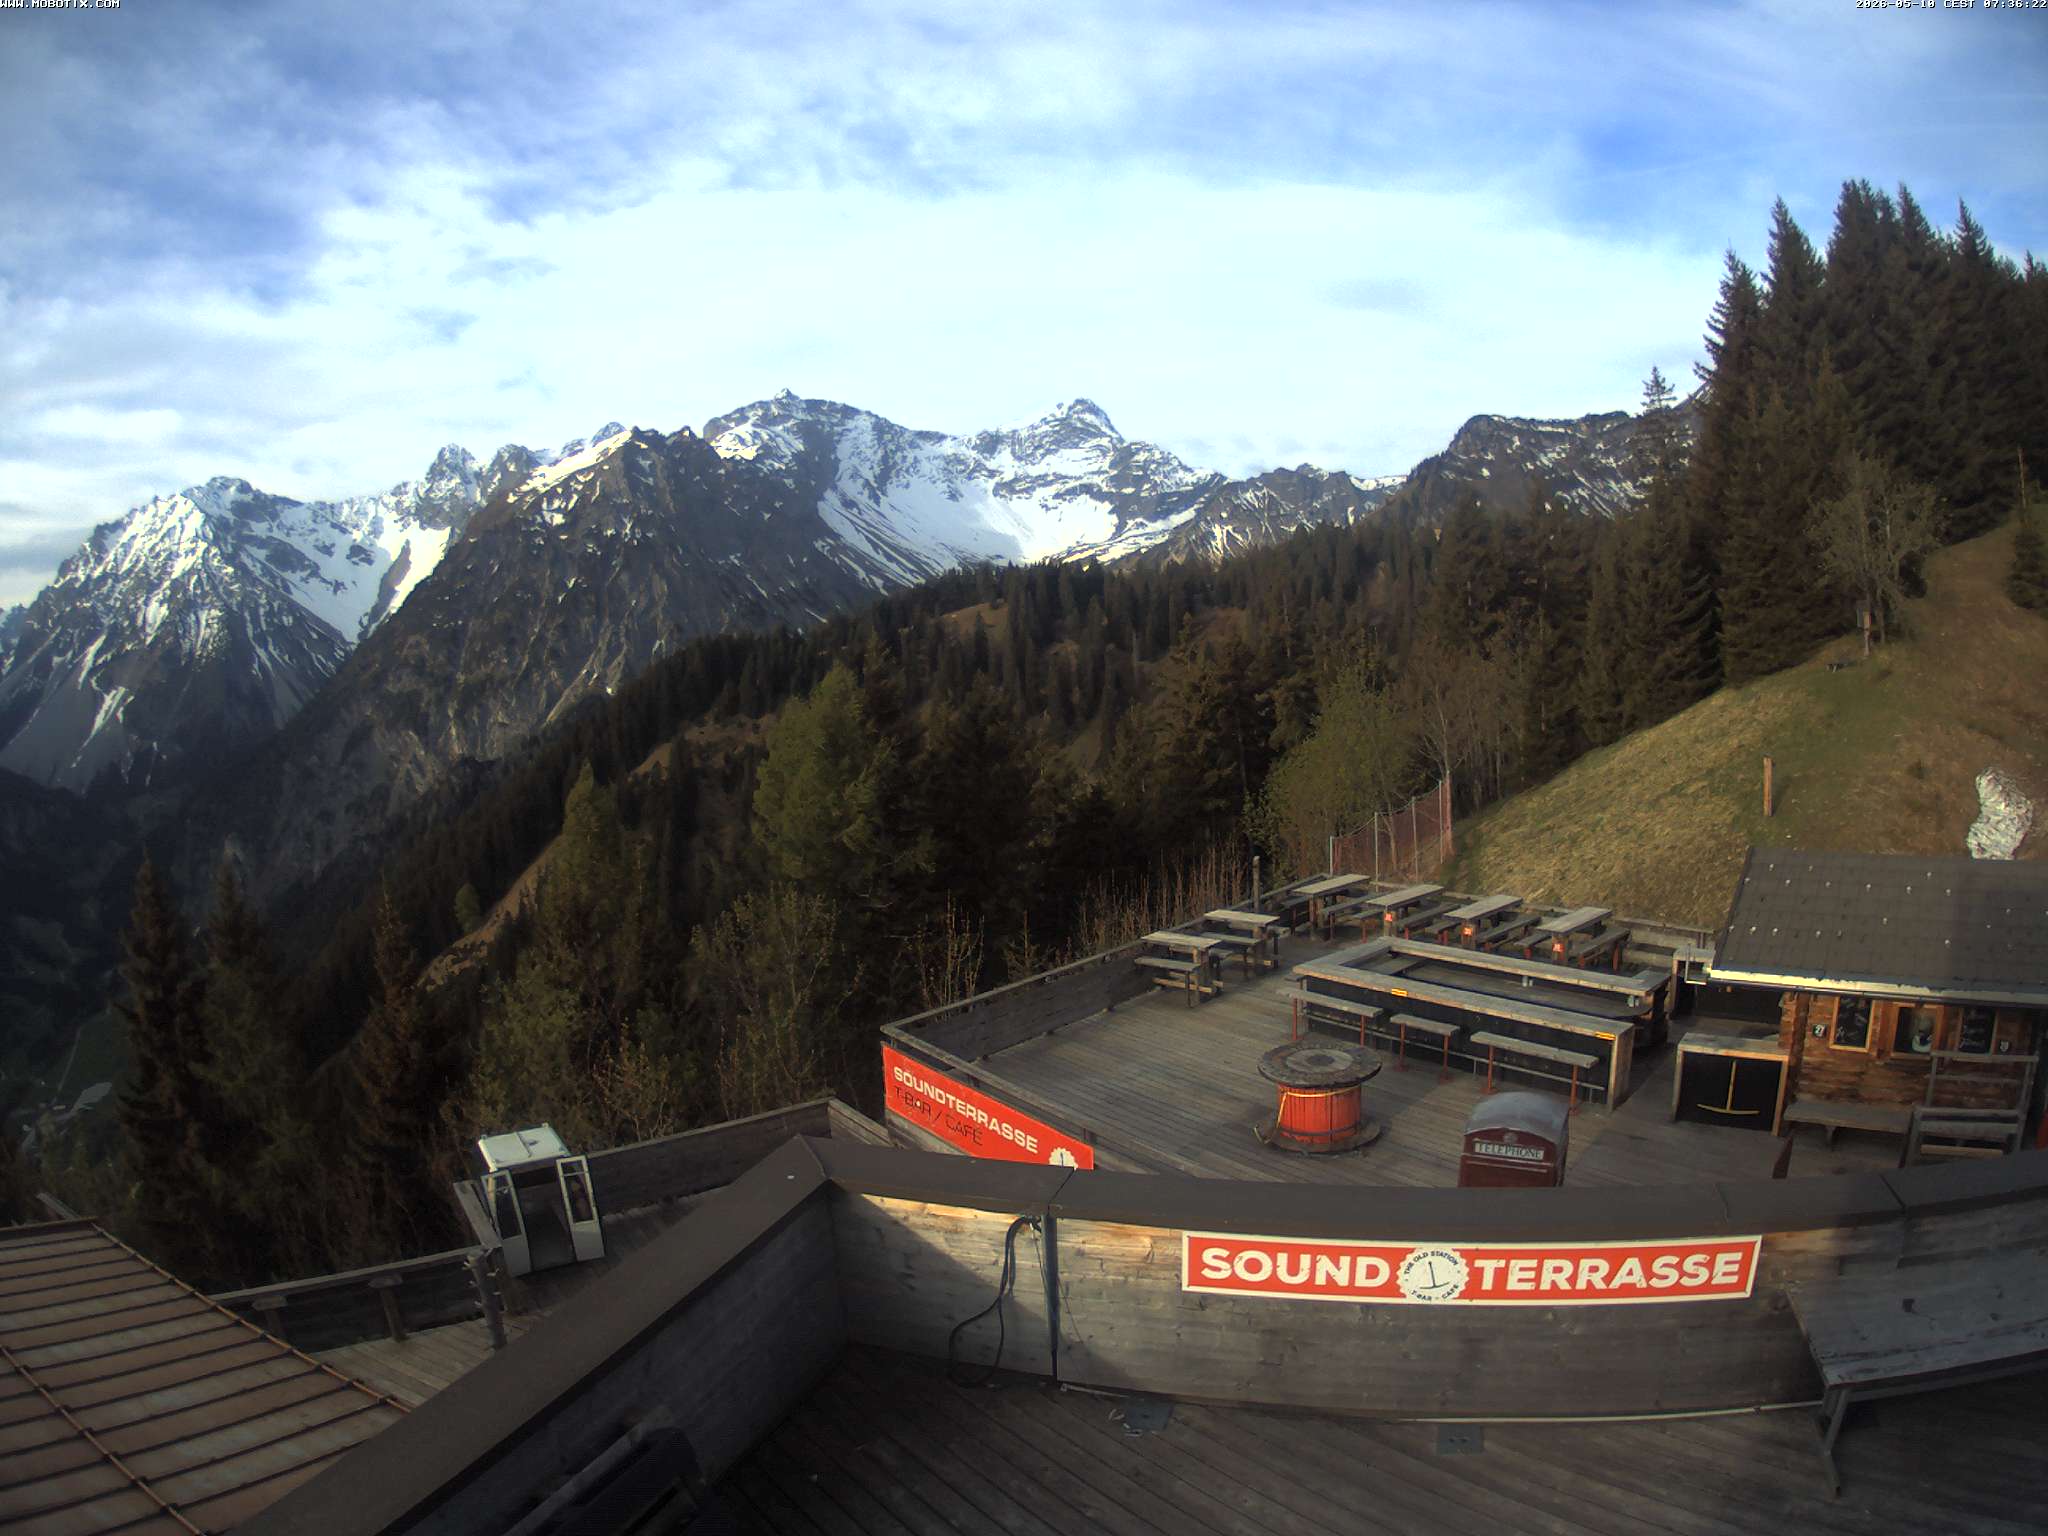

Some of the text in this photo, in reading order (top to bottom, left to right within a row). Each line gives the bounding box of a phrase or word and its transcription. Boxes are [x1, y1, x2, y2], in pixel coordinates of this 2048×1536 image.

[893, 1066, 1038, 1154] SOUNDTERRASSE
[1477, 1143, 1541, 1159] TELEPHONE
[1200, 1247, 1743, 1292] SOUND TERRASSE
[1404, 1251, 1459, 1275] THE OLD STATION
